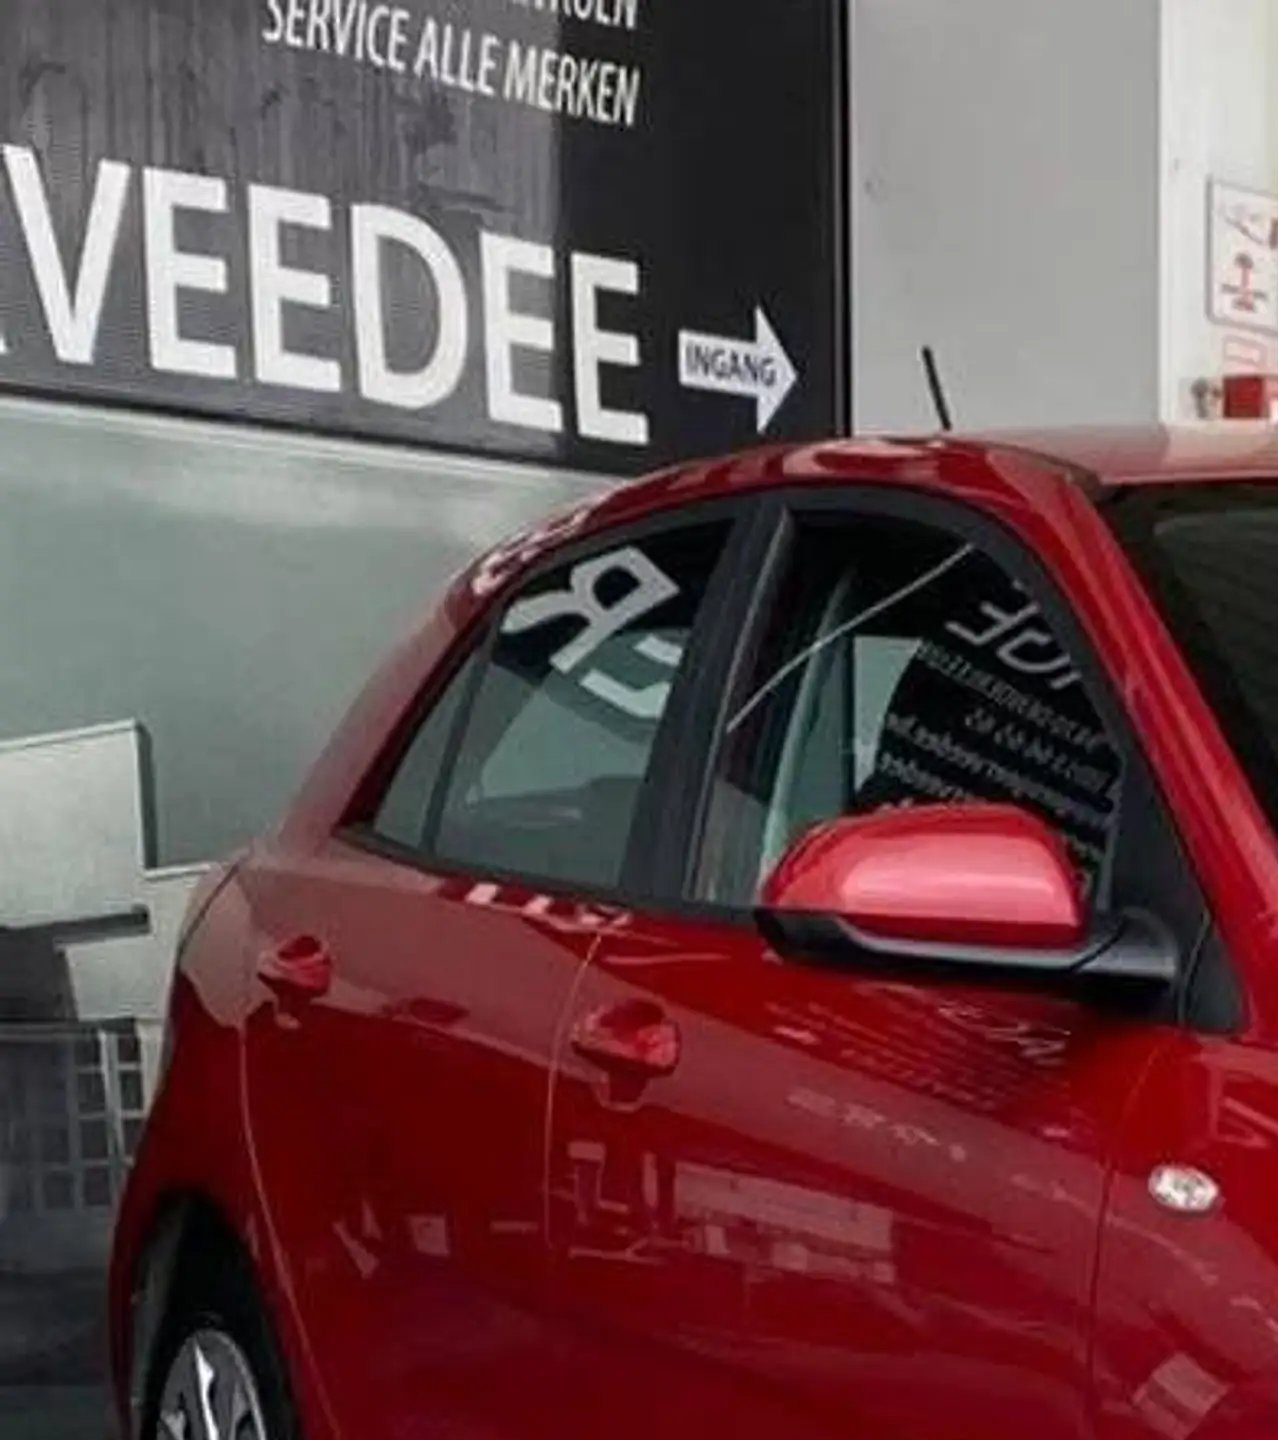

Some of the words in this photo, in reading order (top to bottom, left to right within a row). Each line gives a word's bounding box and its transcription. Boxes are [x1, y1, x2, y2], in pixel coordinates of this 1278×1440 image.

[262, 0, 411, 72] SERVICE
[413, 17, 502, 97] ALLE
[503, 40, 641, 126] MERKEN
[0, 144, 650, 446] VEEDEE
[685, 341, 776, 388] INGANG
